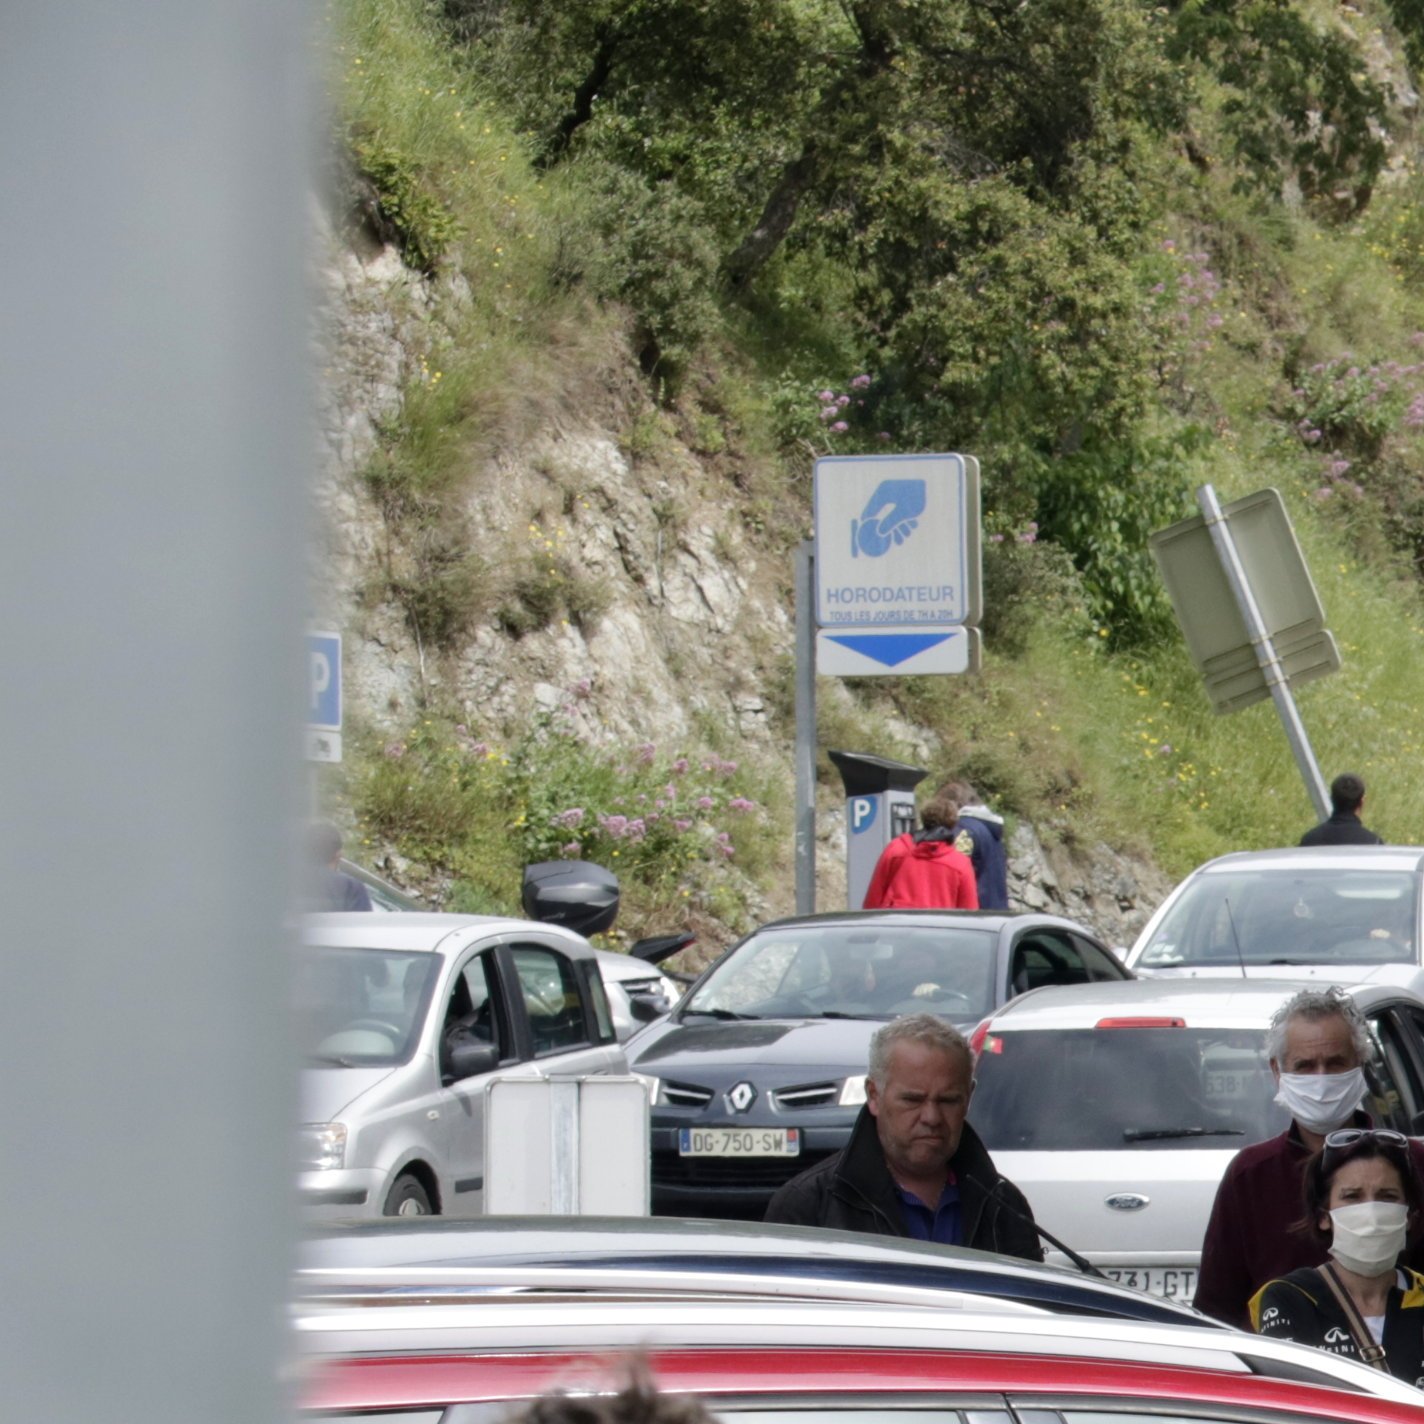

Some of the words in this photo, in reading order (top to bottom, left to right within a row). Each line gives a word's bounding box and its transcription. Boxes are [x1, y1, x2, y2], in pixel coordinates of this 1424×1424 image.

[826, 585, 954, 604] HORODATEUR
[830, 610, 852, 622] TOUS
[853, 799, 871, 828] P
[693, 1132, 783, 1152] DG-750-SW
